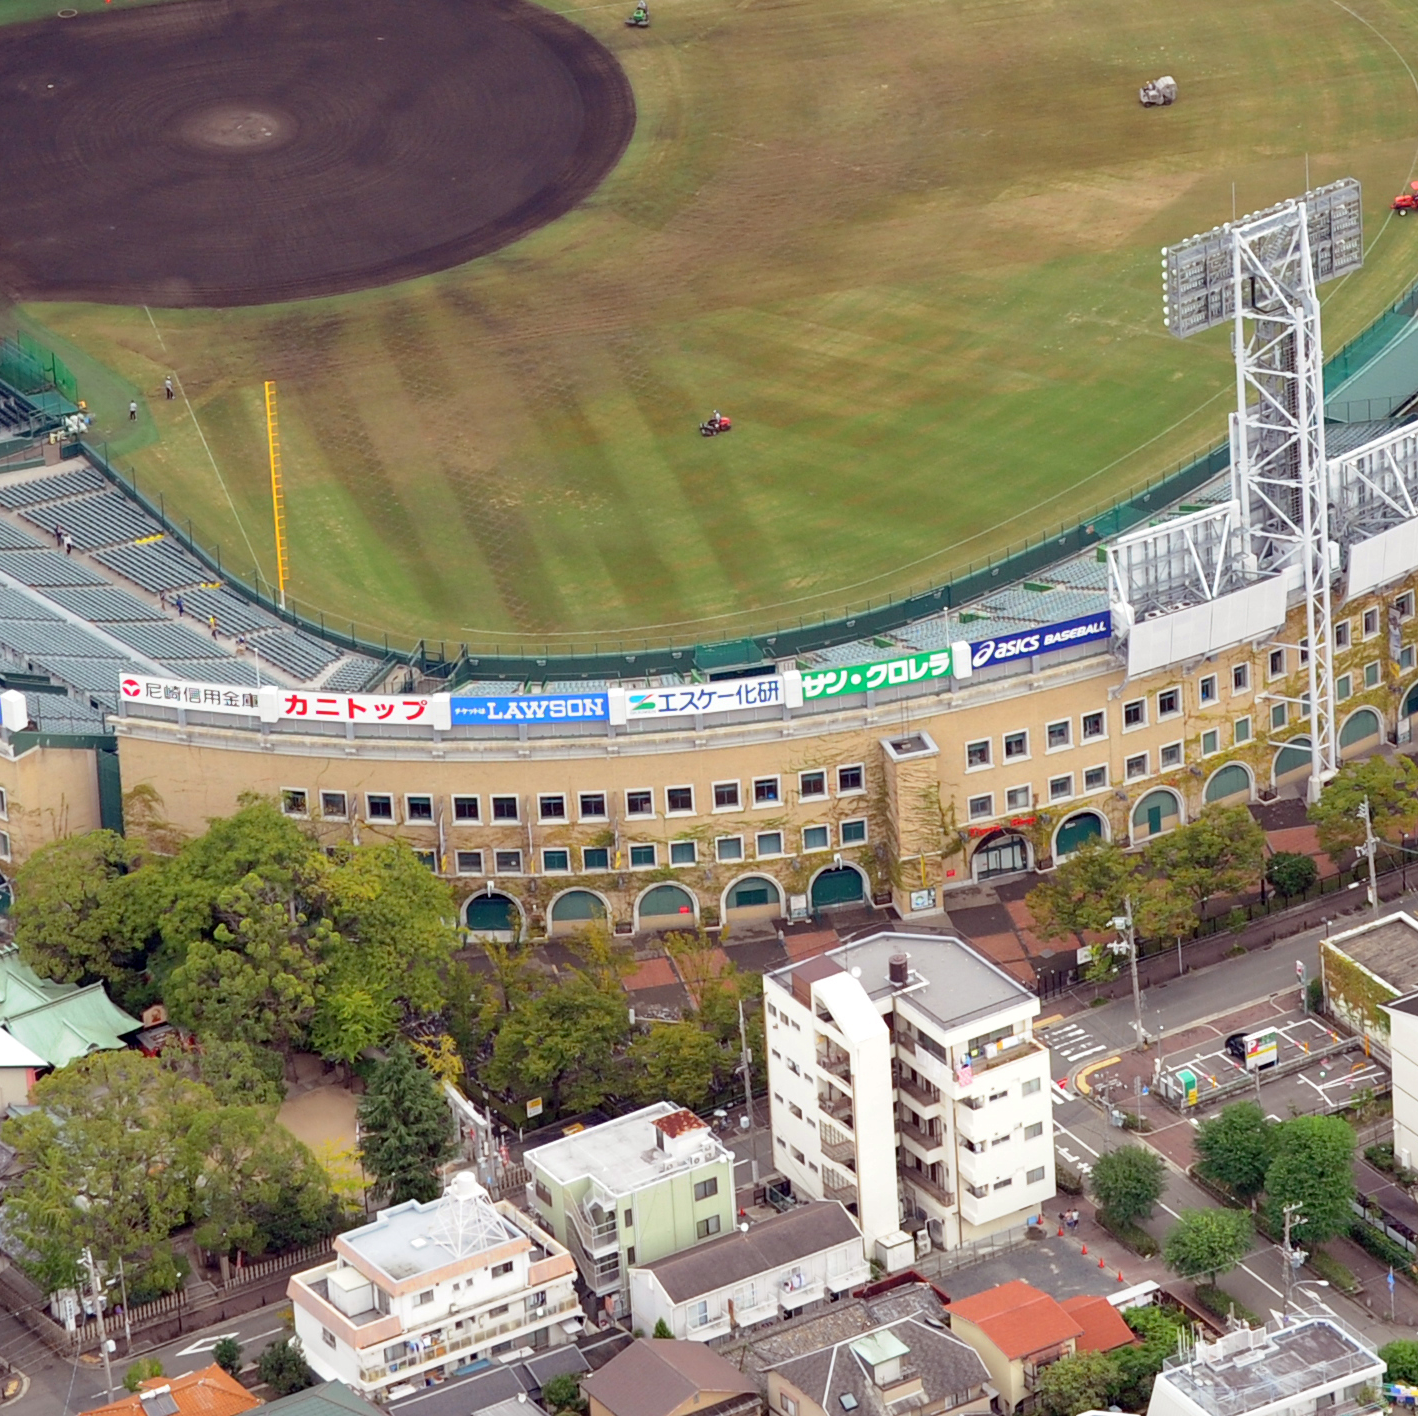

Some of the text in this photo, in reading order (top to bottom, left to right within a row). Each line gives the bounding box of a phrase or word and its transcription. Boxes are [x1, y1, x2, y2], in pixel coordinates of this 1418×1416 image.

[1044, 621, 1106, 645] BASEBALL
[803, 652, 949, 697] サン・クロレラ
[145, 682, 259, 708] 尼崎信用金庫
[285, 694, 428, 721] カニトップ
[658, 679, 780, 713] エスケー化研
[487, 698, 604, 719] LAWSON
[1247, 1039, 1257, 1053] P
